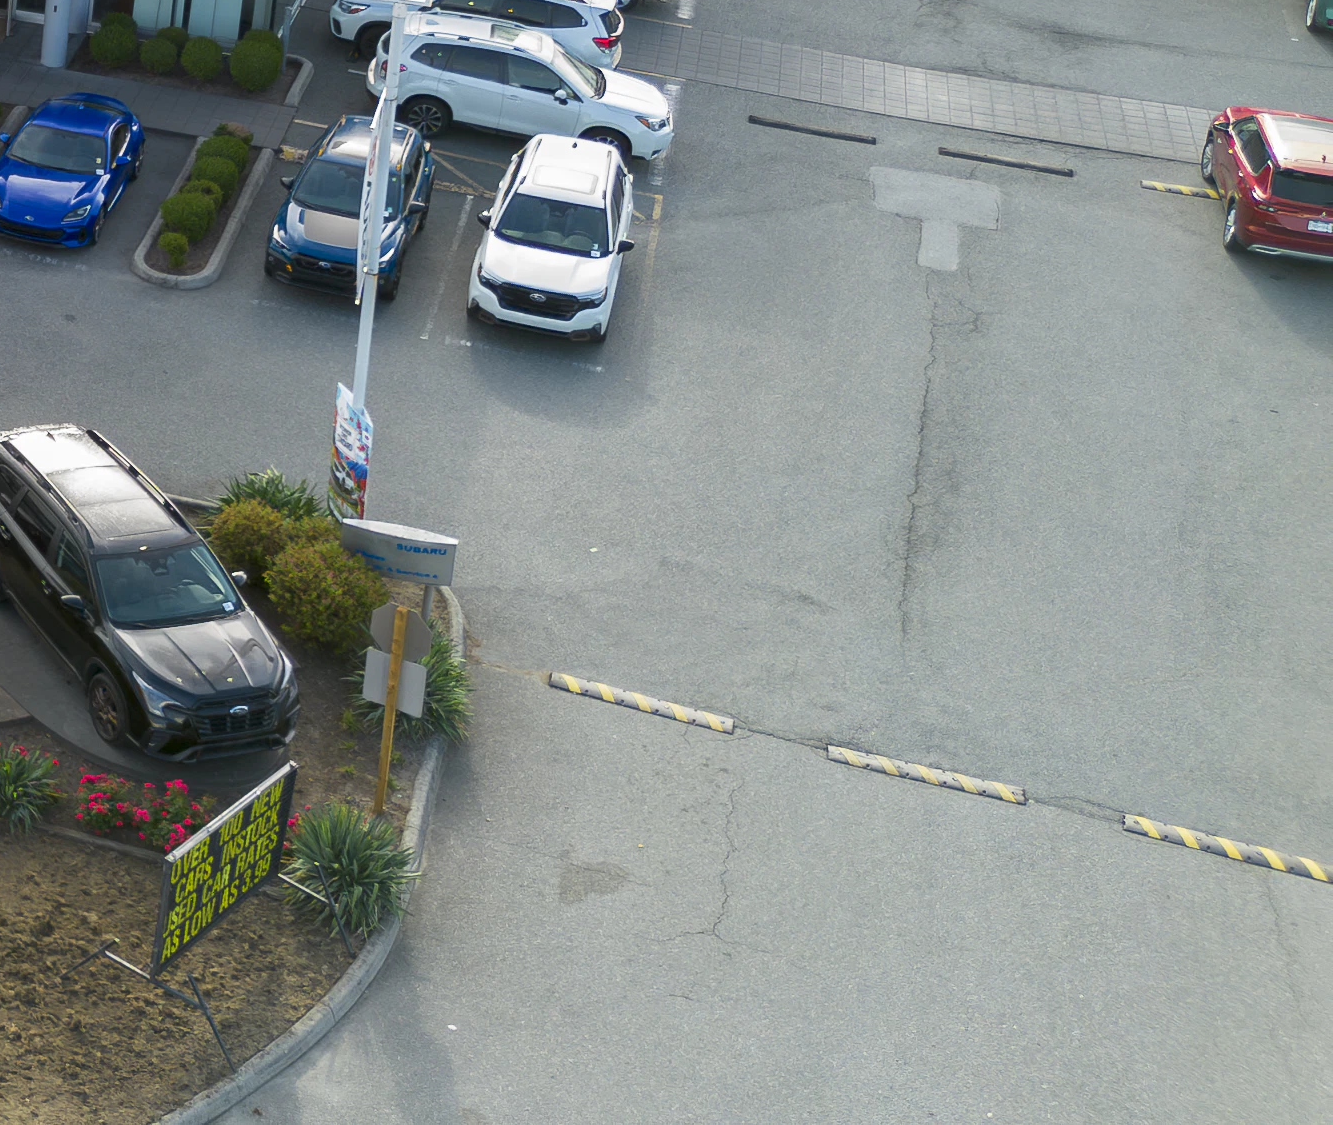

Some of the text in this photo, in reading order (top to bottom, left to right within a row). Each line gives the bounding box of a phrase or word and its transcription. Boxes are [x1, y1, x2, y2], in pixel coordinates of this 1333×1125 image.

[396, 543, 447, 556] SUBARU
[171, 778, 285, 884] OVER 100 NEW
[175, 802, 281, 904] CARS INSTOCK
[202, 864, 231, 904] CAR
[235, 825, 280, 877] RATES
[161, 853, 272, 964] AS LOW AS 3.99
